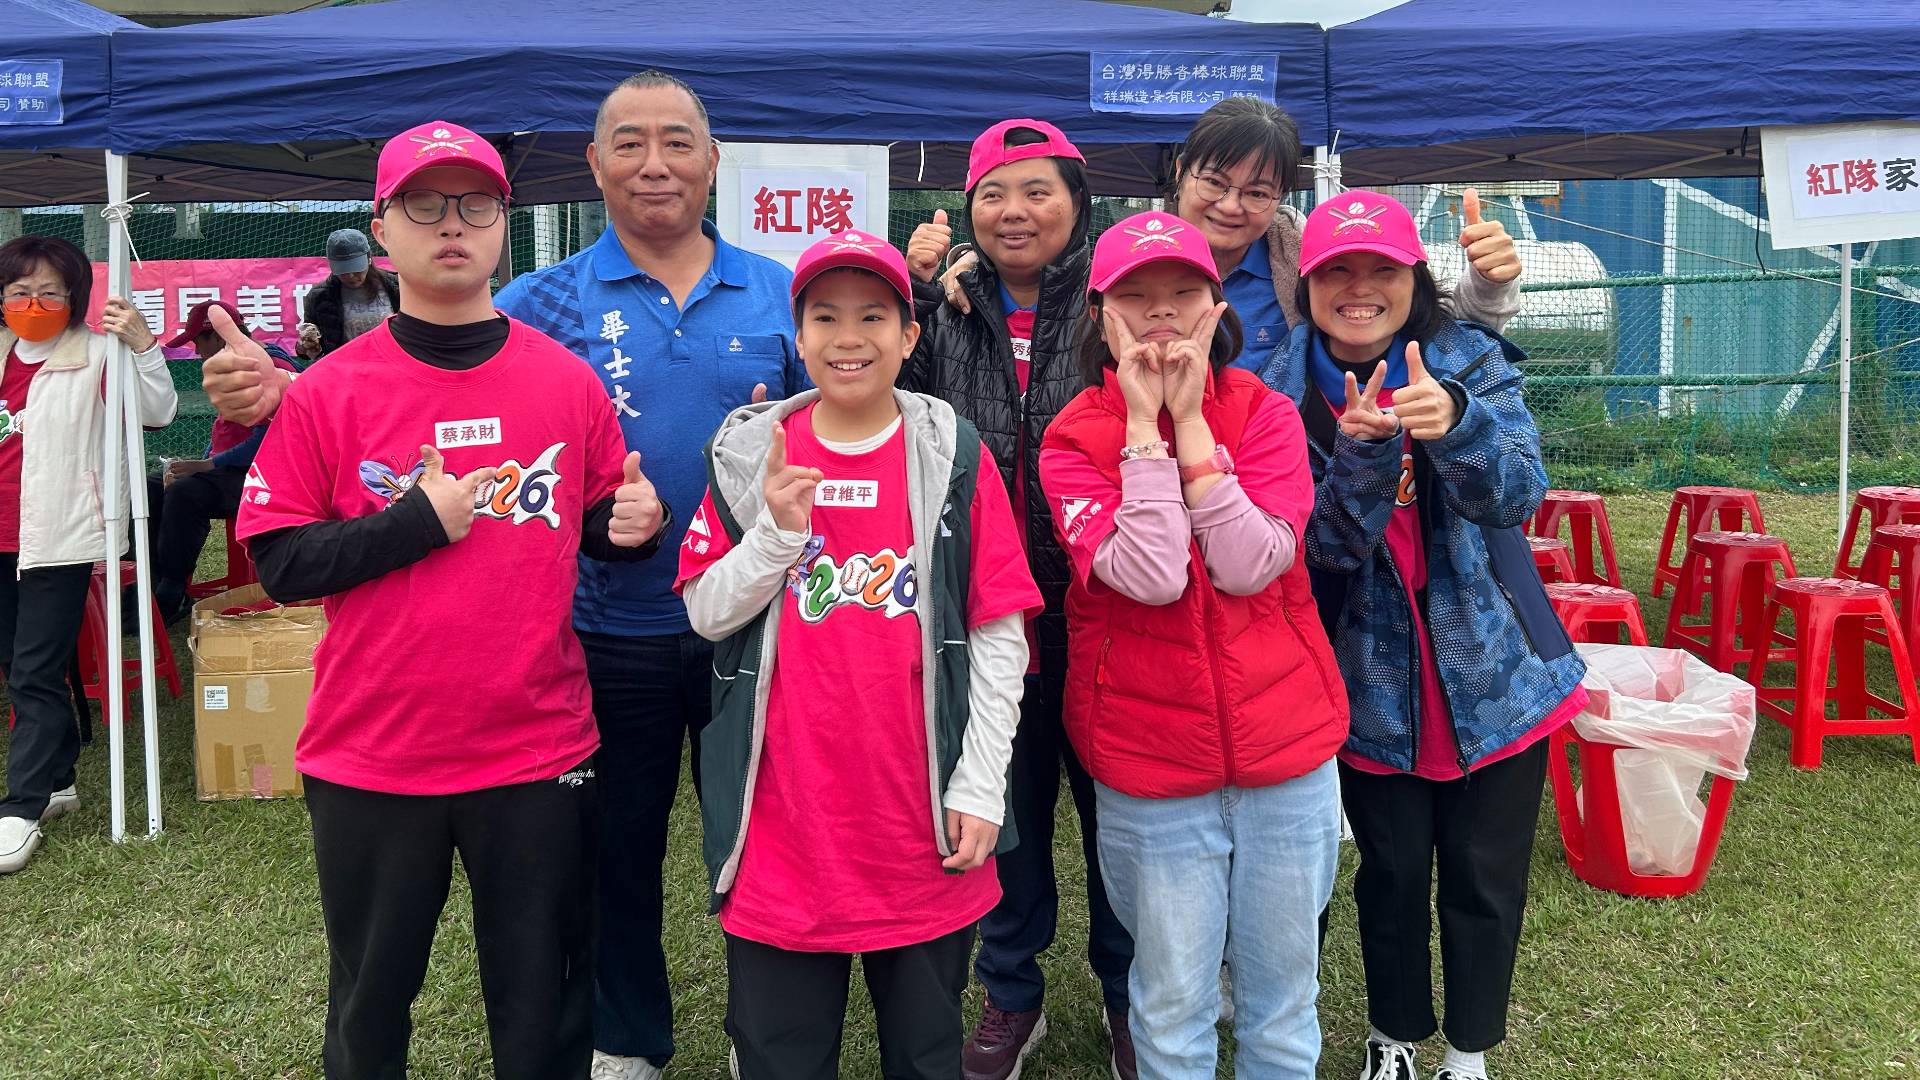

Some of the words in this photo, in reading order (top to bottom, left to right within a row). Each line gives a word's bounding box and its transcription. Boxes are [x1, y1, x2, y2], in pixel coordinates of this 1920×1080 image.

[1806, 157, 1919, 196] 紅隊家
[753, 185, 854, 235] 紅隊
[600, 310, 642, 418] 畢士大
[441, 423, 496, 443] 蔡承財
[821, 485, 873, 502] 曾維平
